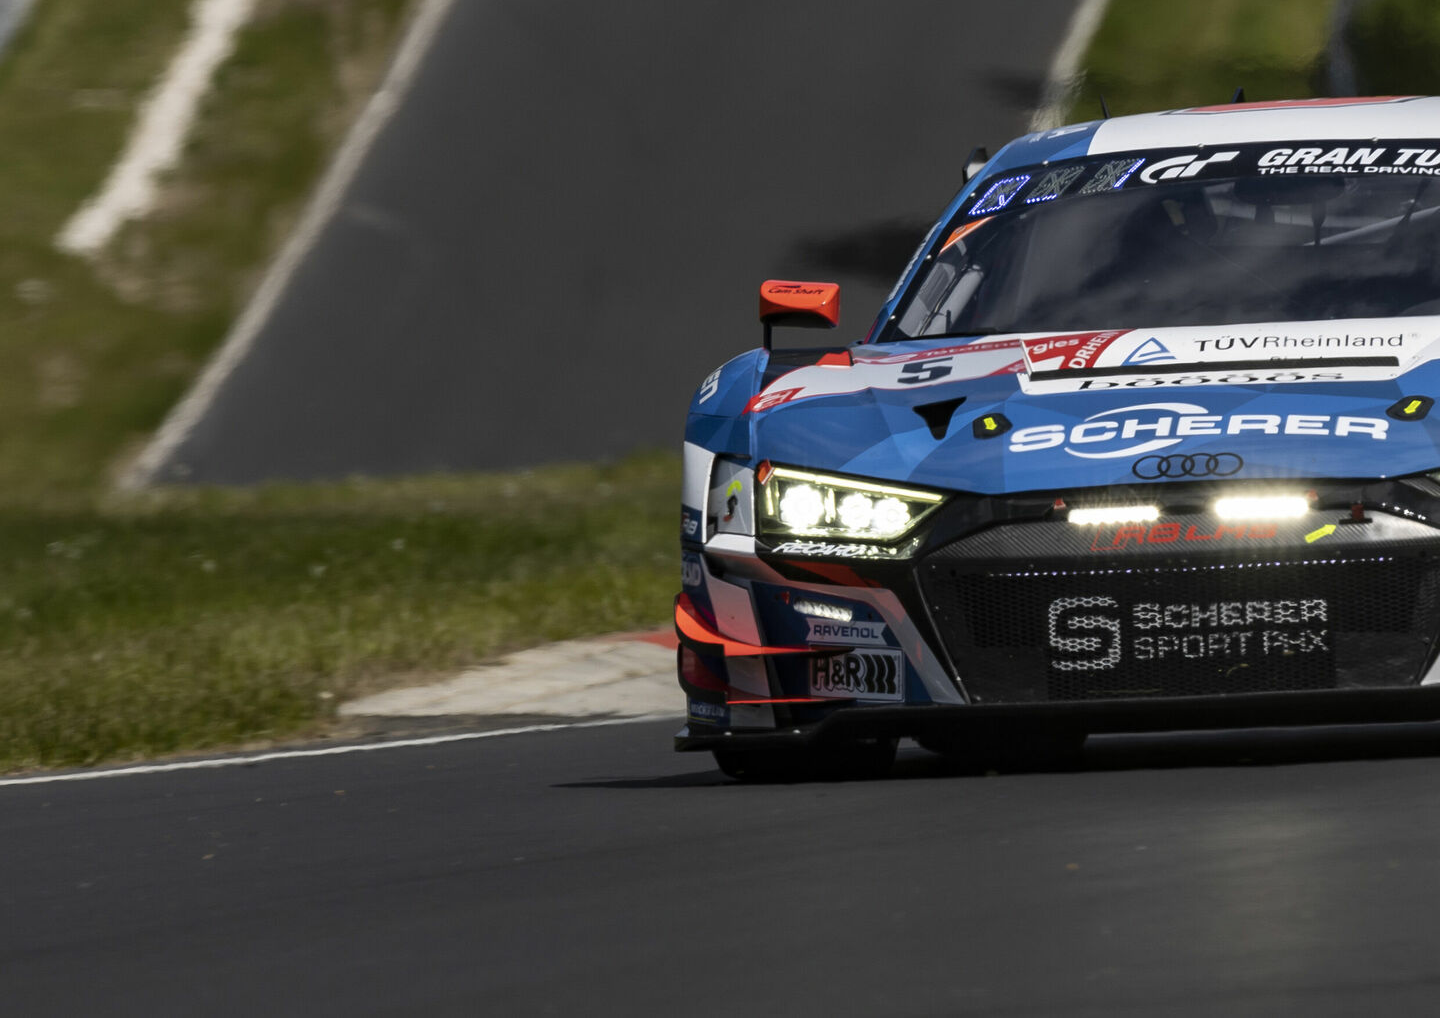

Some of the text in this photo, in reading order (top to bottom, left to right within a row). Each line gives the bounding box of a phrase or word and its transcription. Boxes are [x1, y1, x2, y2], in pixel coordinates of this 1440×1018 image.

[1257, 147, 1386, 167] GRAN
[1258, 166, 1299, 175] THE
[1304, 166, 1359, 174] REAL
[897, 355, 954, 384] 5
[1009, 414, 1390, 453] SCHERER
[1132, 599, 1328, 629] SCHERER
[813, 624, 879, 639] RAVENOL
[1134, 631, 1252, 659] SPORT
[812, 653, 865, 692] H&R
